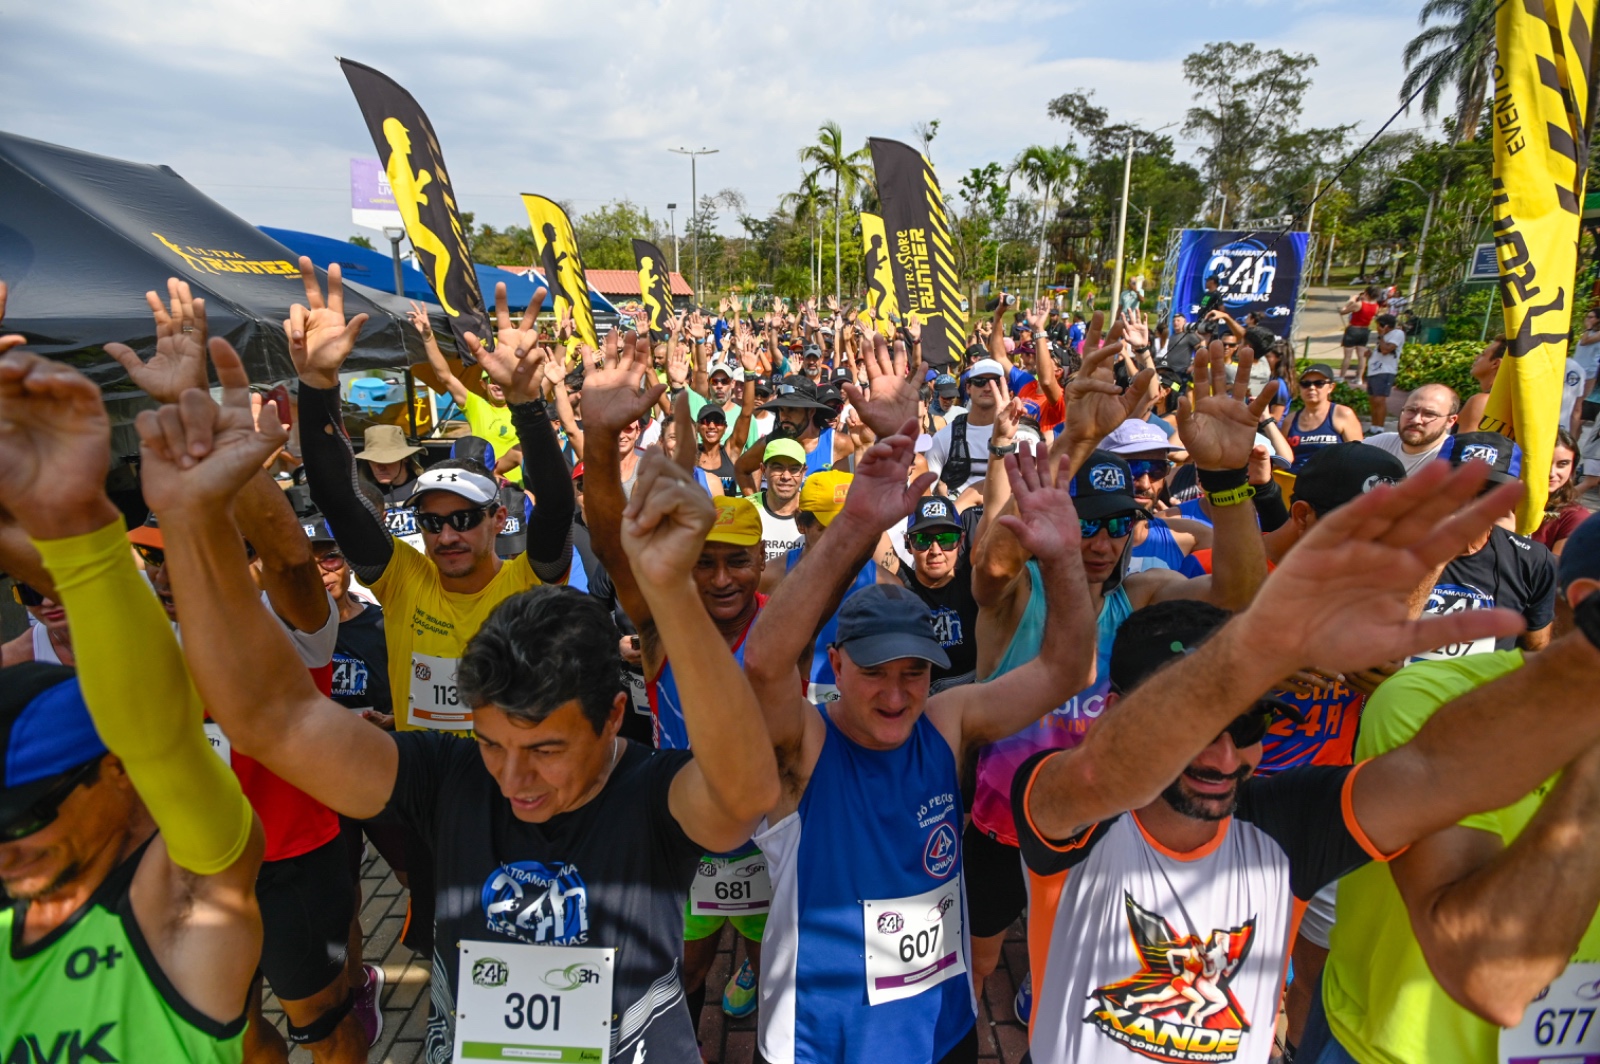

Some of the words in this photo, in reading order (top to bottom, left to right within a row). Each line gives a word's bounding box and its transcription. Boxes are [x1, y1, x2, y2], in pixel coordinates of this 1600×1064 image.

[186, 246, 246, 260] ULTRA
[909, 228, 937, 309] RUNNER
[1301, 435, 1338, 443] LIMITES
[1092, 469, 1126, 487] 24h
[1432, 588, 1494, 601] TRAMARATONA
[932, 613, 963, 641] 4h
[332, 663, 368, 689] 4h
[714, 880, 751, 900] 681
[899, 923, 940, 963] 607
[578, 968, 600, 985] 3h
[504, 992, 561, 1031] 301
[1094, 994, 1242, 1054] XANDE
[1534, 1007, 1598, 1047] 677
